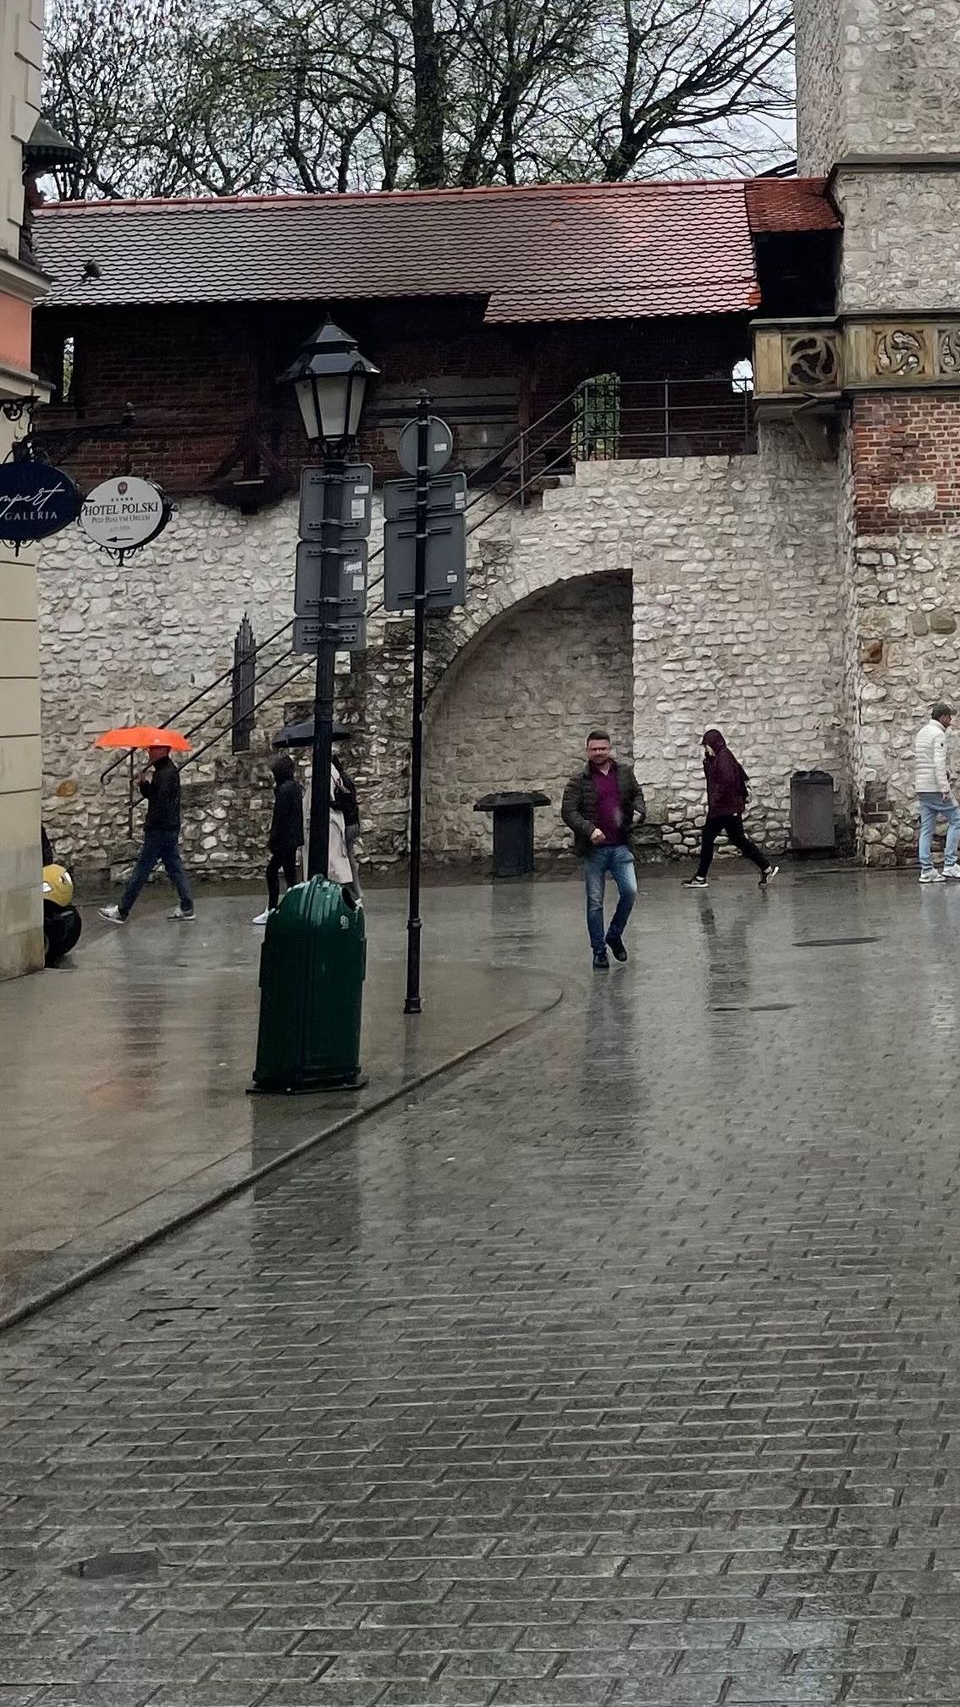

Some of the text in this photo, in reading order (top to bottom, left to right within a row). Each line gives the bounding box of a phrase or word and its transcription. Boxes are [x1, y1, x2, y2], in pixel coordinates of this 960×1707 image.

[85, 501, 159, 516] HOTEL POLSKI
[4, 511, 58, 521] GALERIA
